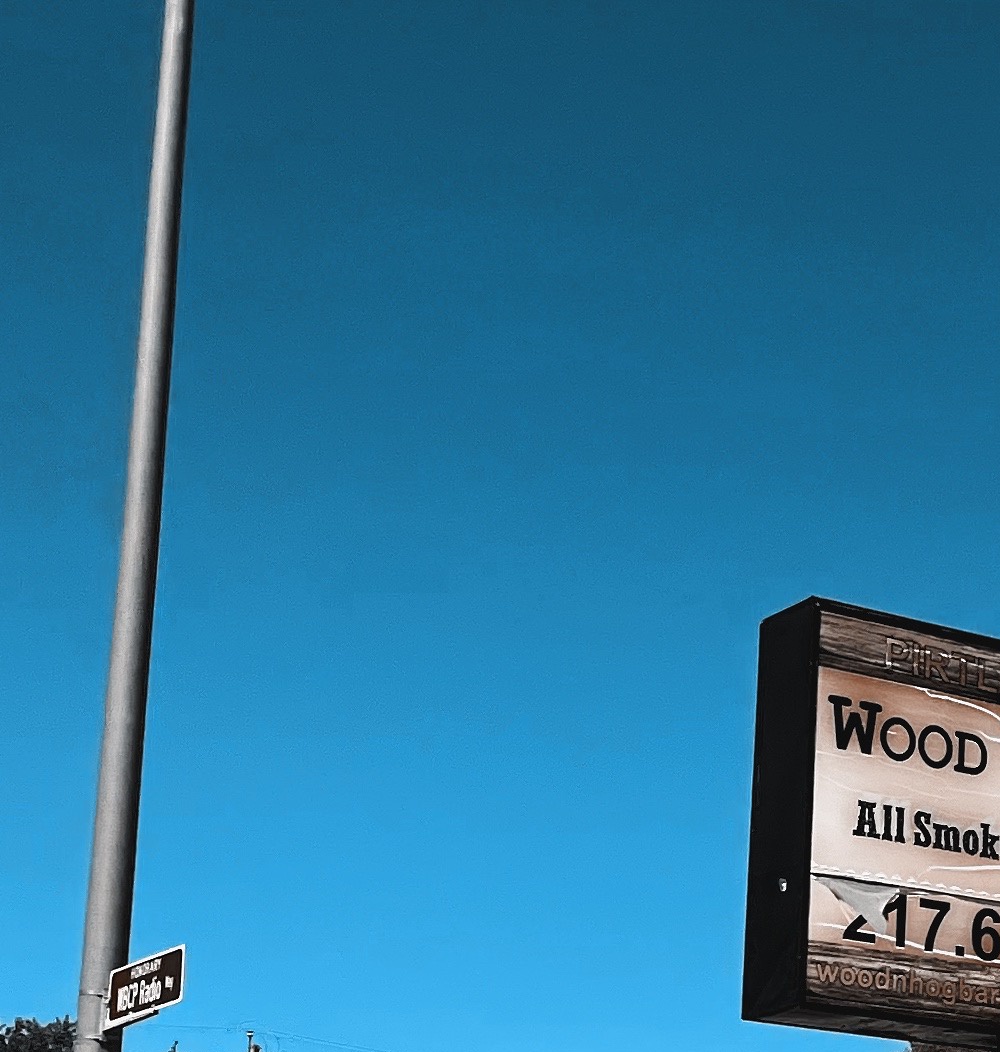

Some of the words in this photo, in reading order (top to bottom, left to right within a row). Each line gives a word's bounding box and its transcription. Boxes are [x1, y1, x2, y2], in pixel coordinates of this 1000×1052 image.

[827, 694, 988, 776] WOOD
[852, 799, 906, 844] All
[139, 976, 161, 1005] Radio
